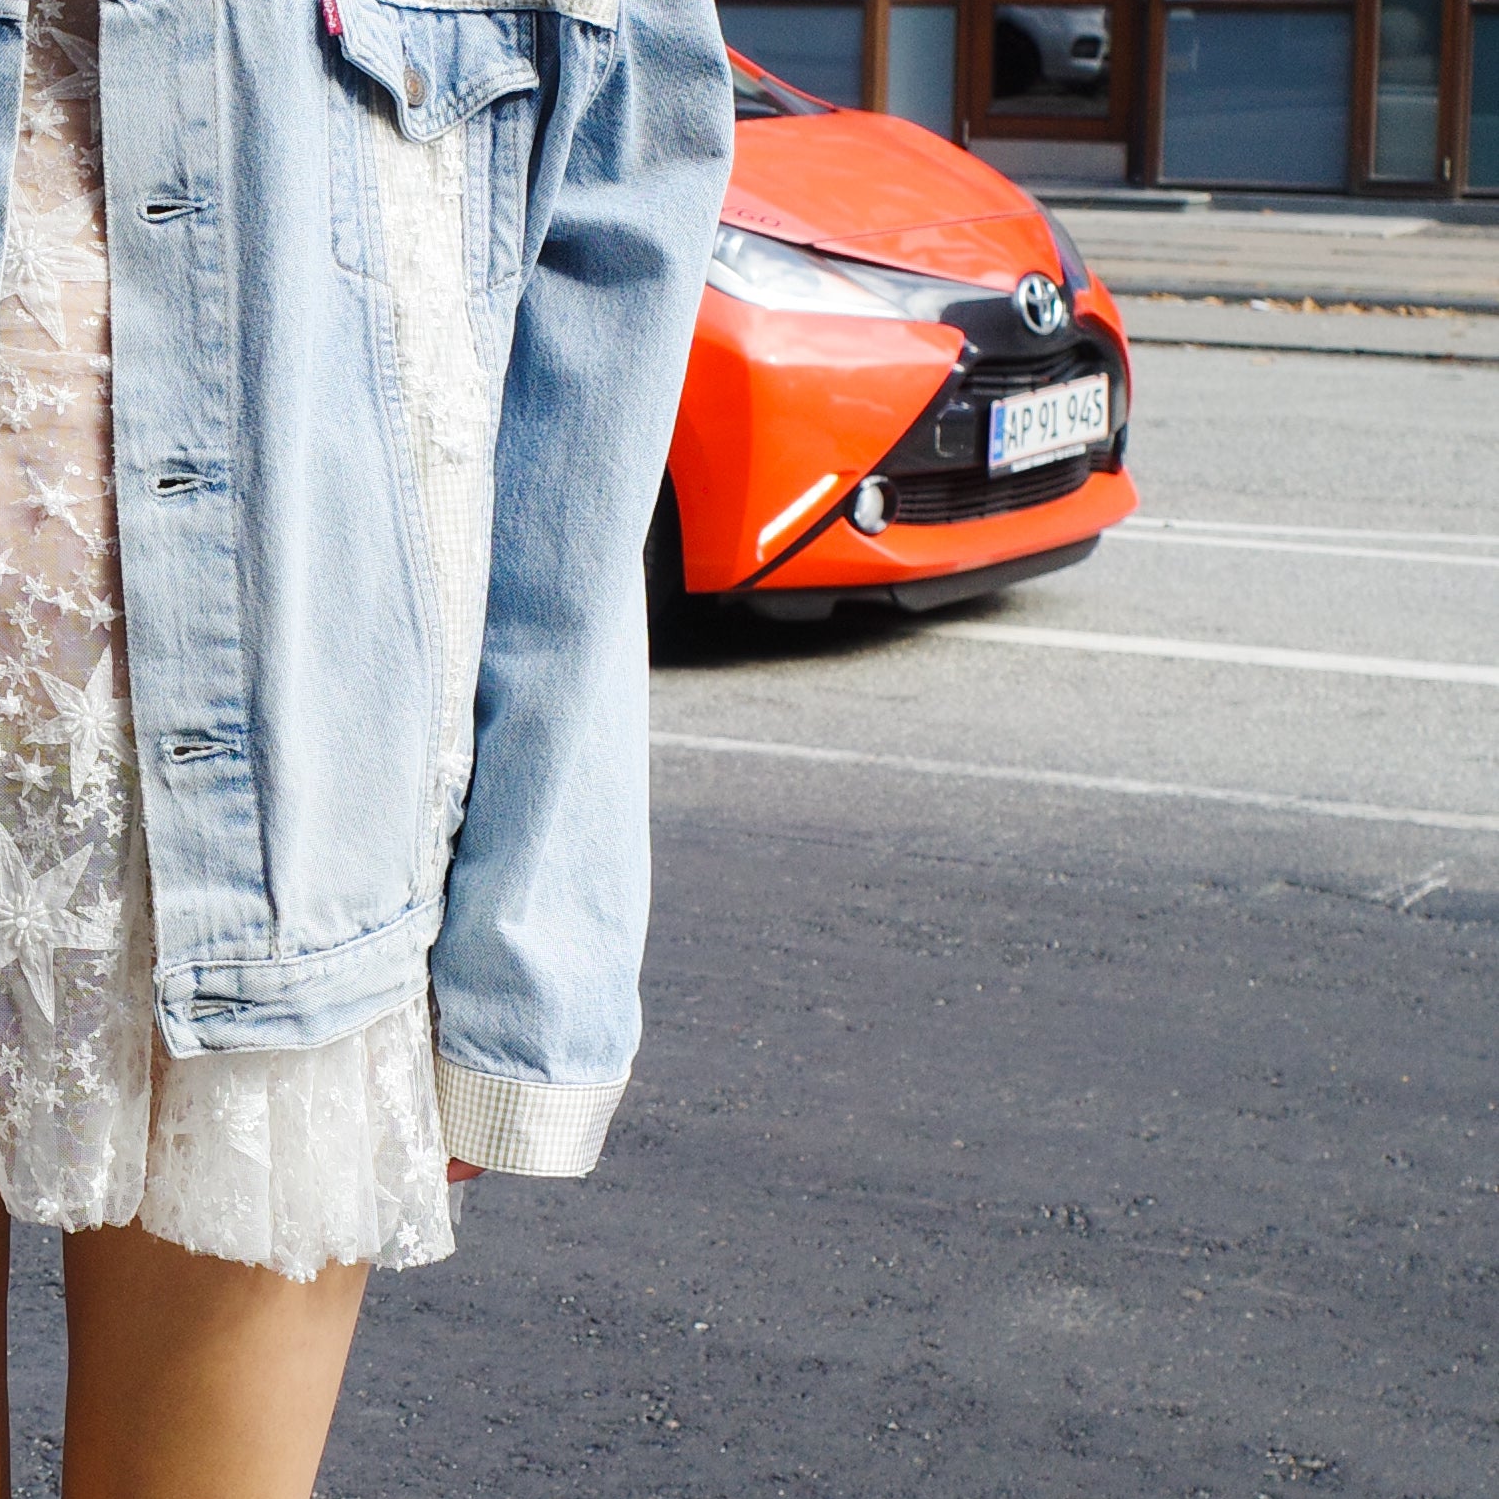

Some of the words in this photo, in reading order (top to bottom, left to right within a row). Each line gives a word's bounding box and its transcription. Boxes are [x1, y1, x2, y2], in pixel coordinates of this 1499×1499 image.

[1006, 407, 1033, 449] AP
[1039, 401, 1059, 442] 91
[1067, 388, 1103, 435] 945
